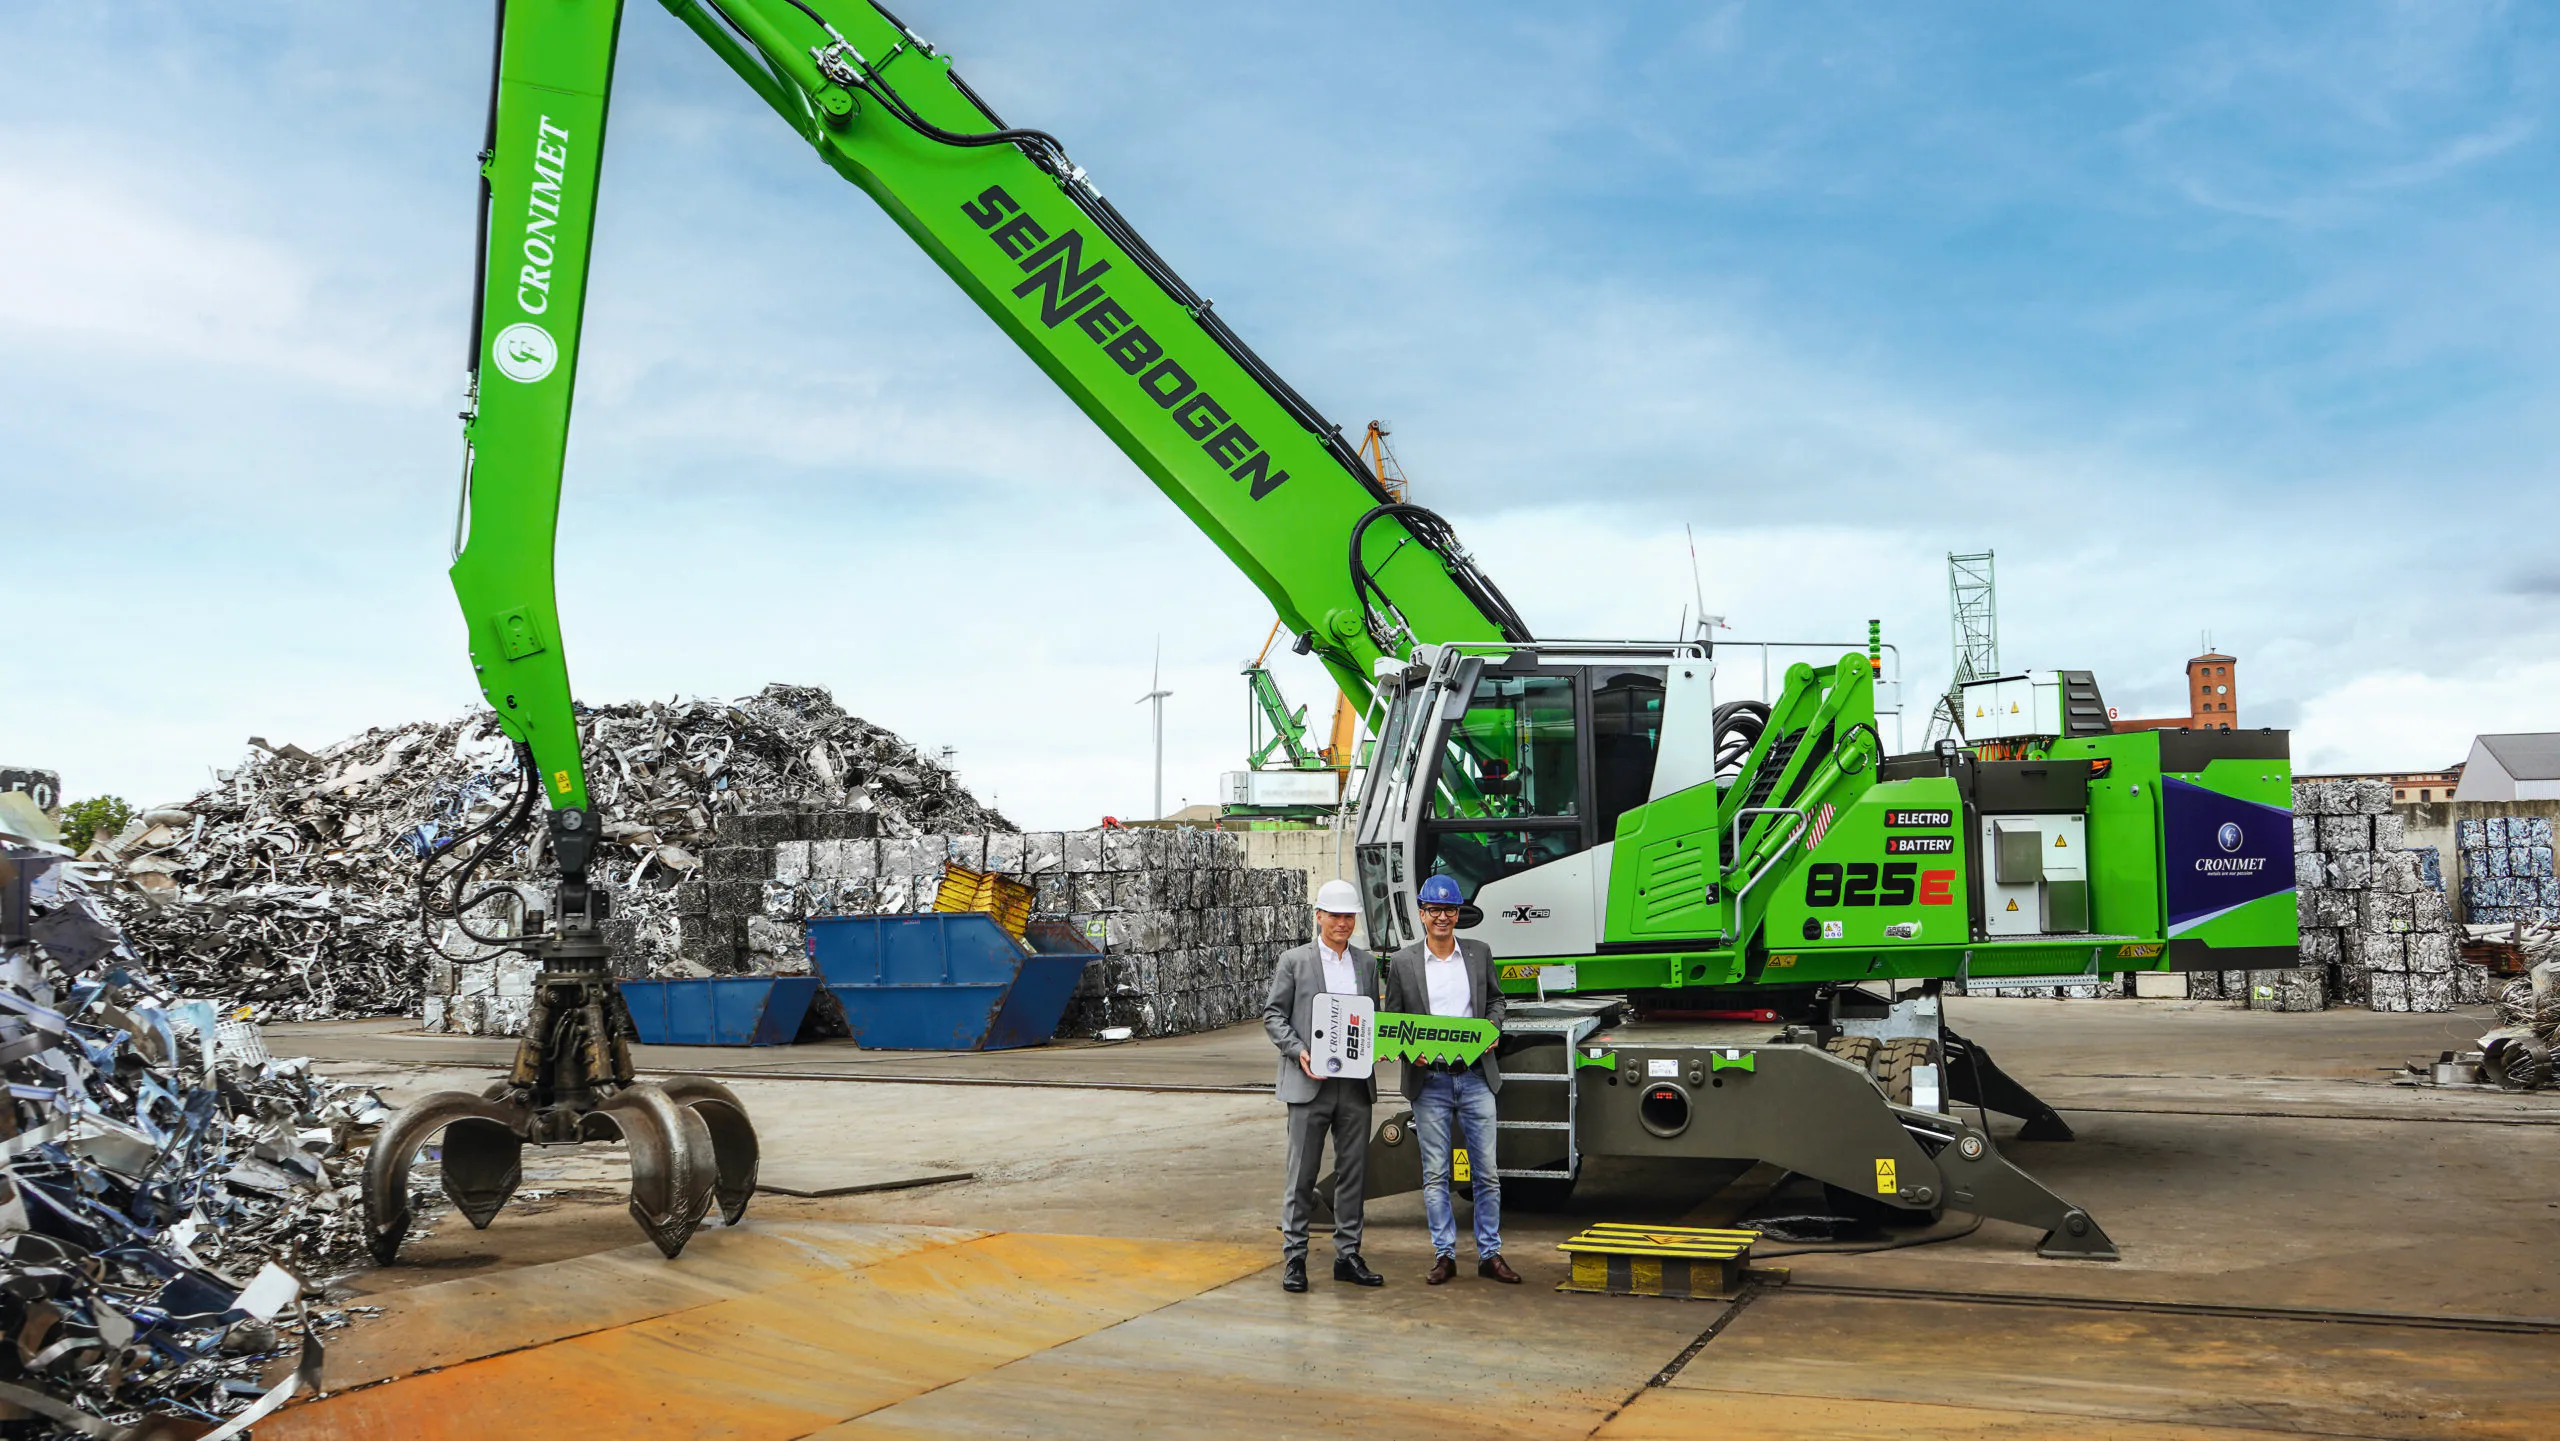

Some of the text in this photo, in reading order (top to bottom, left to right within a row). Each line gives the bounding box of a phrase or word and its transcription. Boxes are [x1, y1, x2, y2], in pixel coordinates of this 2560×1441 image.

[517, 114, 569, 315] CRONIMET
[960, 184, 1291, 502] SENNEBOGEN
[1897, 812, 1949, 824] ELECTRO
[1899, 839, 1952, 851] BATTERY
[2195, 858, 2267, 871] CRONIMET
[1804, 862, 1956, 907] 825E
[1329, 996, 1340, 1054] CRONIMET
[1346, 1013, 1361, 1060] 825E
[1377, 1020, 1482, 1046] SENNEBOGEN
